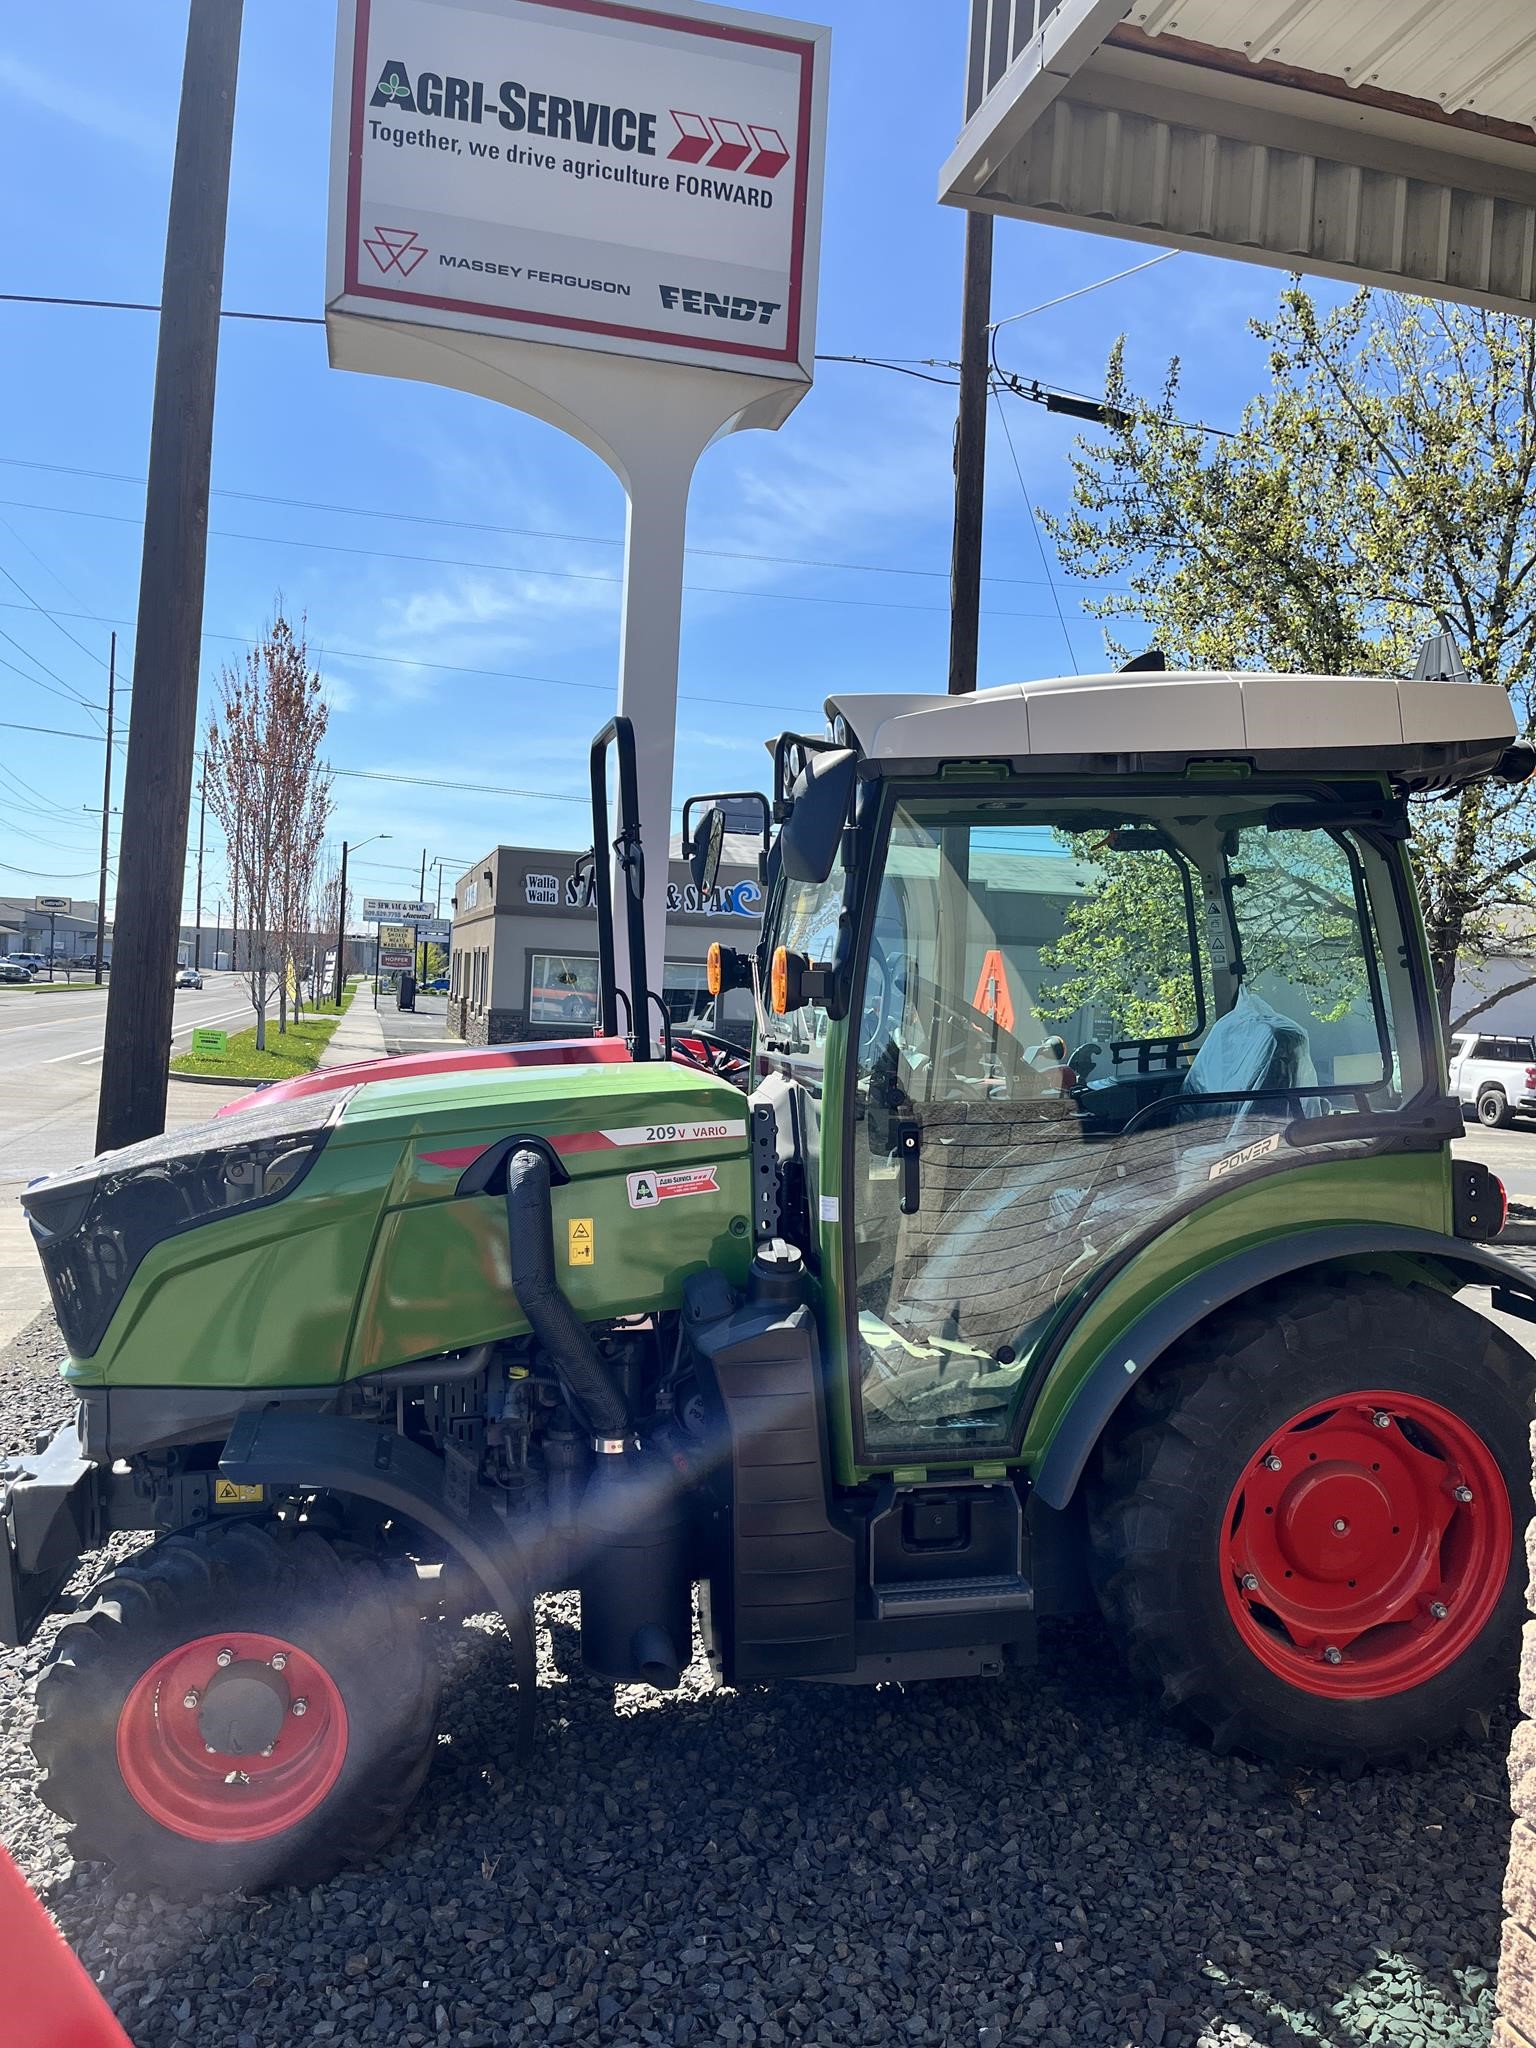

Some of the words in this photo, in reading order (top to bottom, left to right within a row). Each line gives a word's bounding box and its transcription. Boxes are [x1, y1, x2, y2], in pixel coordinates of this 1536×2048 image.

[369, 60, 657, 156] AGRI-SERVICE
[369, 120, 462, 156] Together,
[469, 141, 500, 159] we
[507, 144, 556, 170] drive
[562, 159, 669, 190] agriculture
[676, 174, 773, 209] FORWARD
[439, 254, 523, 278] MASSEY
[527, 269, 631, 296] FERGUSON
[658, 284, 781, 325] FENDT
[528, 876, 556, 889] Walla
[528, 889, 556, 902] Walla
[686, 885, 734, 912] SPAS
[322, 951, 337, 995] SALE
[693, 1126, 727, 1137] VARIO
[1218, 1139, 1272, 1174] POWER
